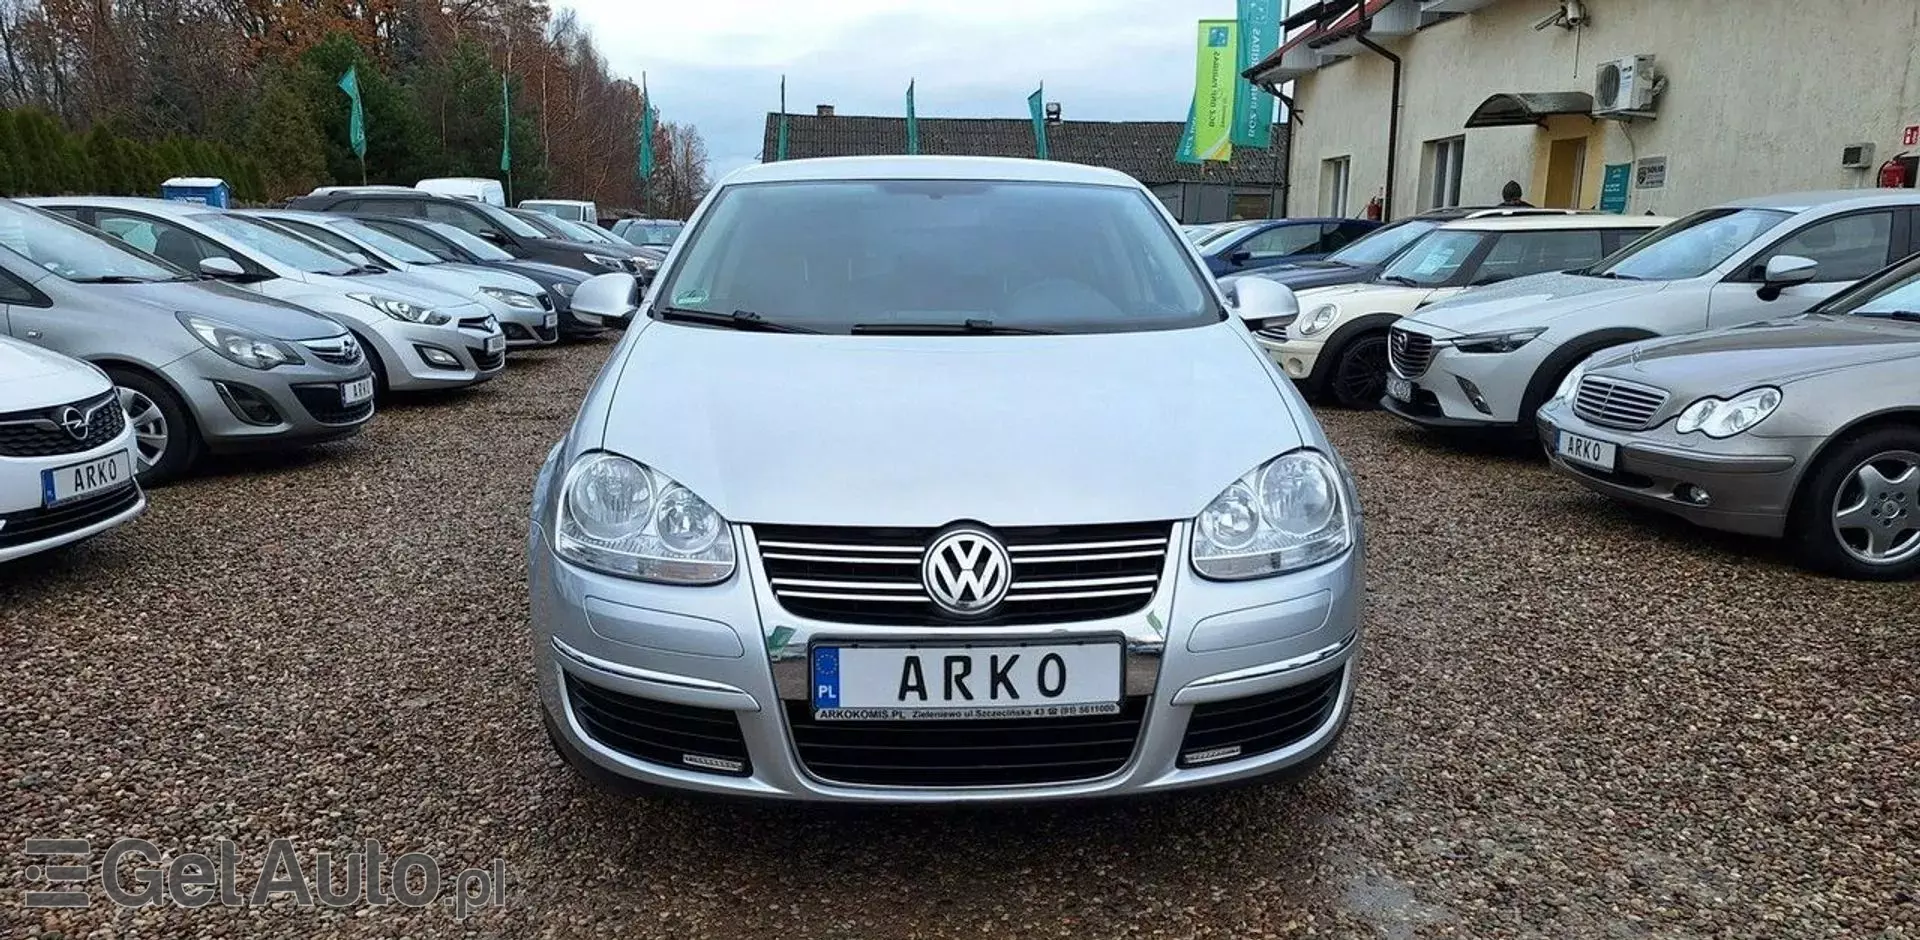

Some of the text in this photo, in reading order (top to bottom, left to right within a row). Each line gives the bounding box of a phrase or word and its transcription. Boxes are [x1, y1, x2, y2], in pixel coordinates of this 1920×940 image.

[1568, 436, 1601, 461] ARKO
[74, 458, 117, 492] ARKO
[898, 653, 1067, 701] ARKO
[819, 685, 837, 699] PL
[1060, 706, 1077, 716] (91)
[1079, 703, 1116, 714] 5611000
